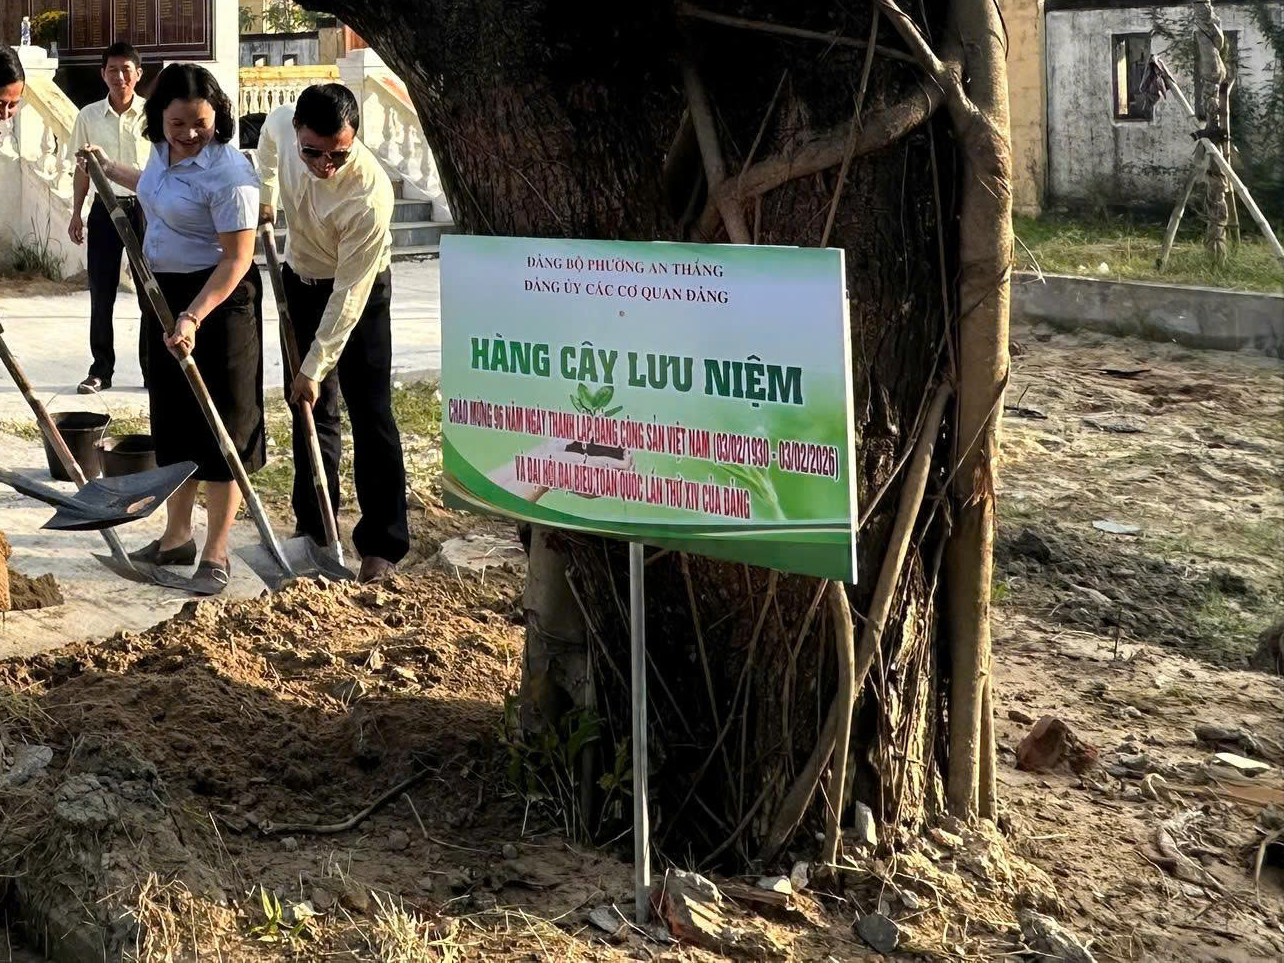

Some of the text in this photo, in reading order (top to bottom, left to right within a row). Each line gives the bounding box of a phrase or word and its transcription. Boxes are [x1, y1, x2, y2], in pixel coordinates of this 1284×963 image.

[524, 277, 728, 303] ĐẢNG ỦY CÁC CƠ QUAN ĐẢNG
[527, 254, 724, 277] ĐẢNG BỘ PHƯỜNG AN THẮNG
[471, 333, 803, 407] HÀNG CÂY LƯU NIỆM
[449, 394, 468, 424] CHÀO
[470, 396, 492, 428] MỪNG
[494, 405, 503, 429] 96
[505, 401, 523, 432] NĂM
[525, 404, 546, 435] NGÀY
[549, 407, 574, 438] THÀNH
[577, 410, 592, 449] LẬP
[594, 408, 617, 443] ĐẢNG
[620, 415, 644, 454] CỘNG
[647, 415, 664, 452] SẢN
[667, 421, 685, 462] VIỆT
[689, 429, 710, 458] NAM
[714, 433, 769, 467] (03/02/1930
[779, 440, 839, 480] 03/02/2026)
[516, 451, 750, 519] VÀ ĐẠI HỘI ĐẠI BIỂU TOÀN QUỐC LẦN THỨ XIV CỦA ĐẢNG
